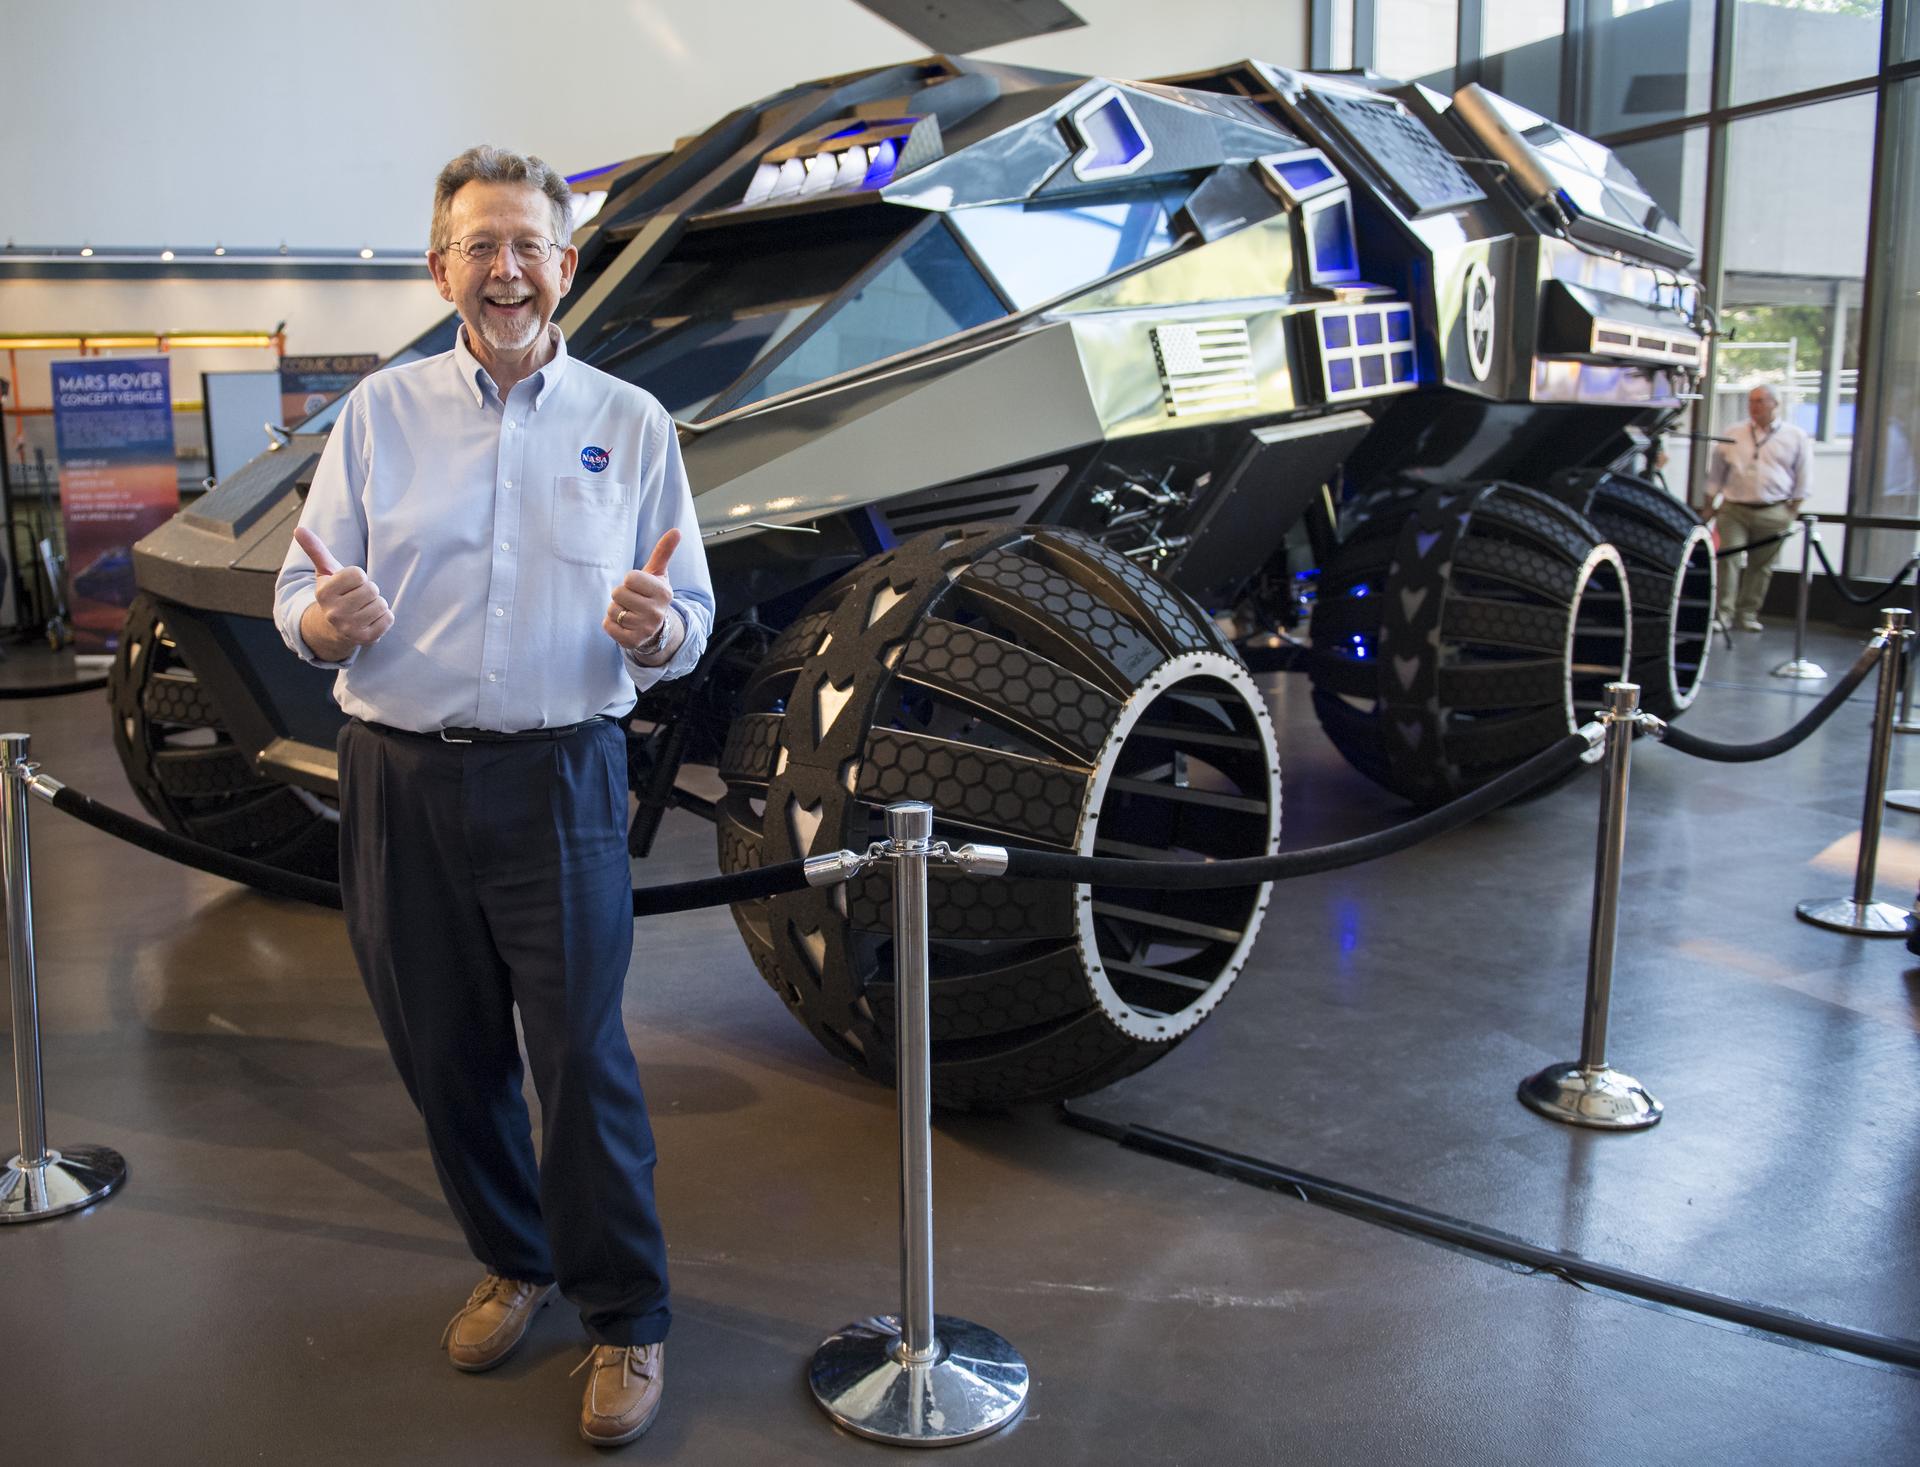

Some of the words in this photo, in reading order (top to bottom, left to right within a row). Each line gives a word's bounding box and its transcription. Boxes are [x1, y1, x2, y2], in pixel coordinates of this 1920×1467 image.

[59, 374, 106, 392] MARS
[107, 371, 162, 390] ROVER
[60, 391, 115, 407] CONCEPT
[117, 389, 164, 405] VEHICLE
[582, 453, 608, 465] NASA
